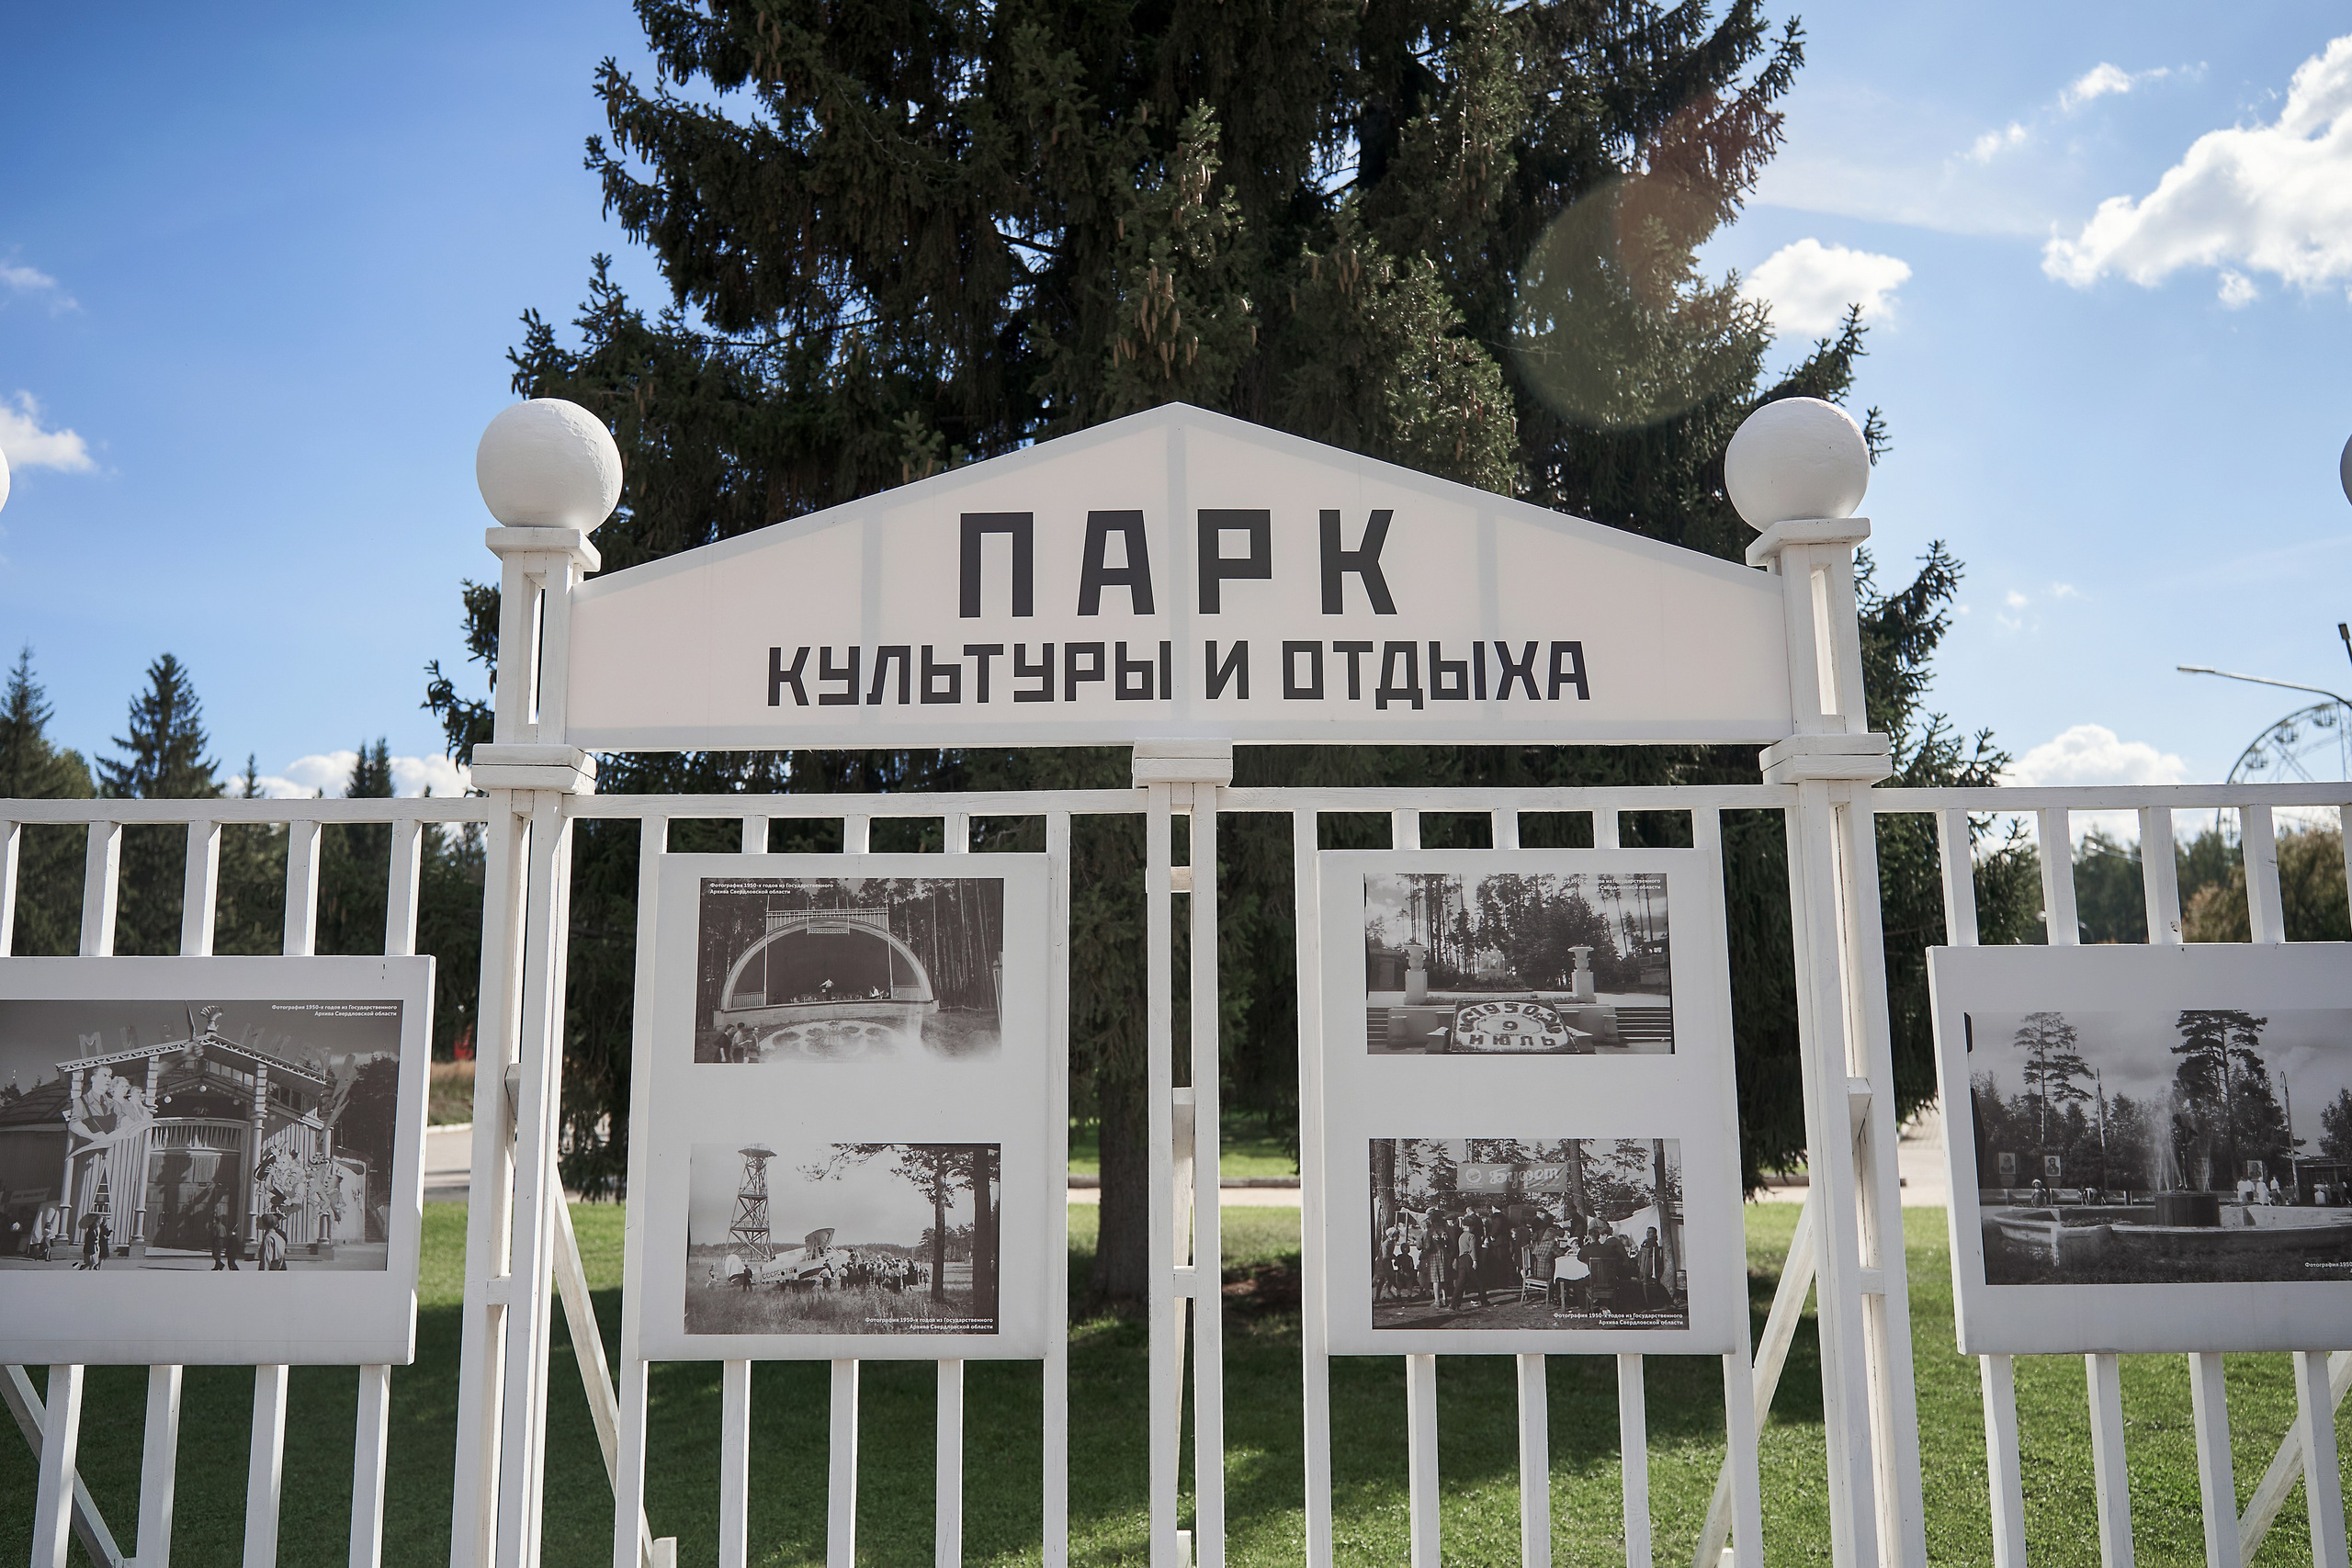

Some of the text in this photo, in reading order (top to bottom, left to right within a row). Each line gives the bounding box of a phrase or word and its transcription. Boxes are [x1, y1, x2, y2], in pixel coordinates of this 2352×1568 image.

[959, 509, 1397, 618] ПАРК
[767, 640, 1591, 711] КУЛЬТУРЫ И ОТДЫХА
[1488, 1168, 1559, 1189] Буфет
